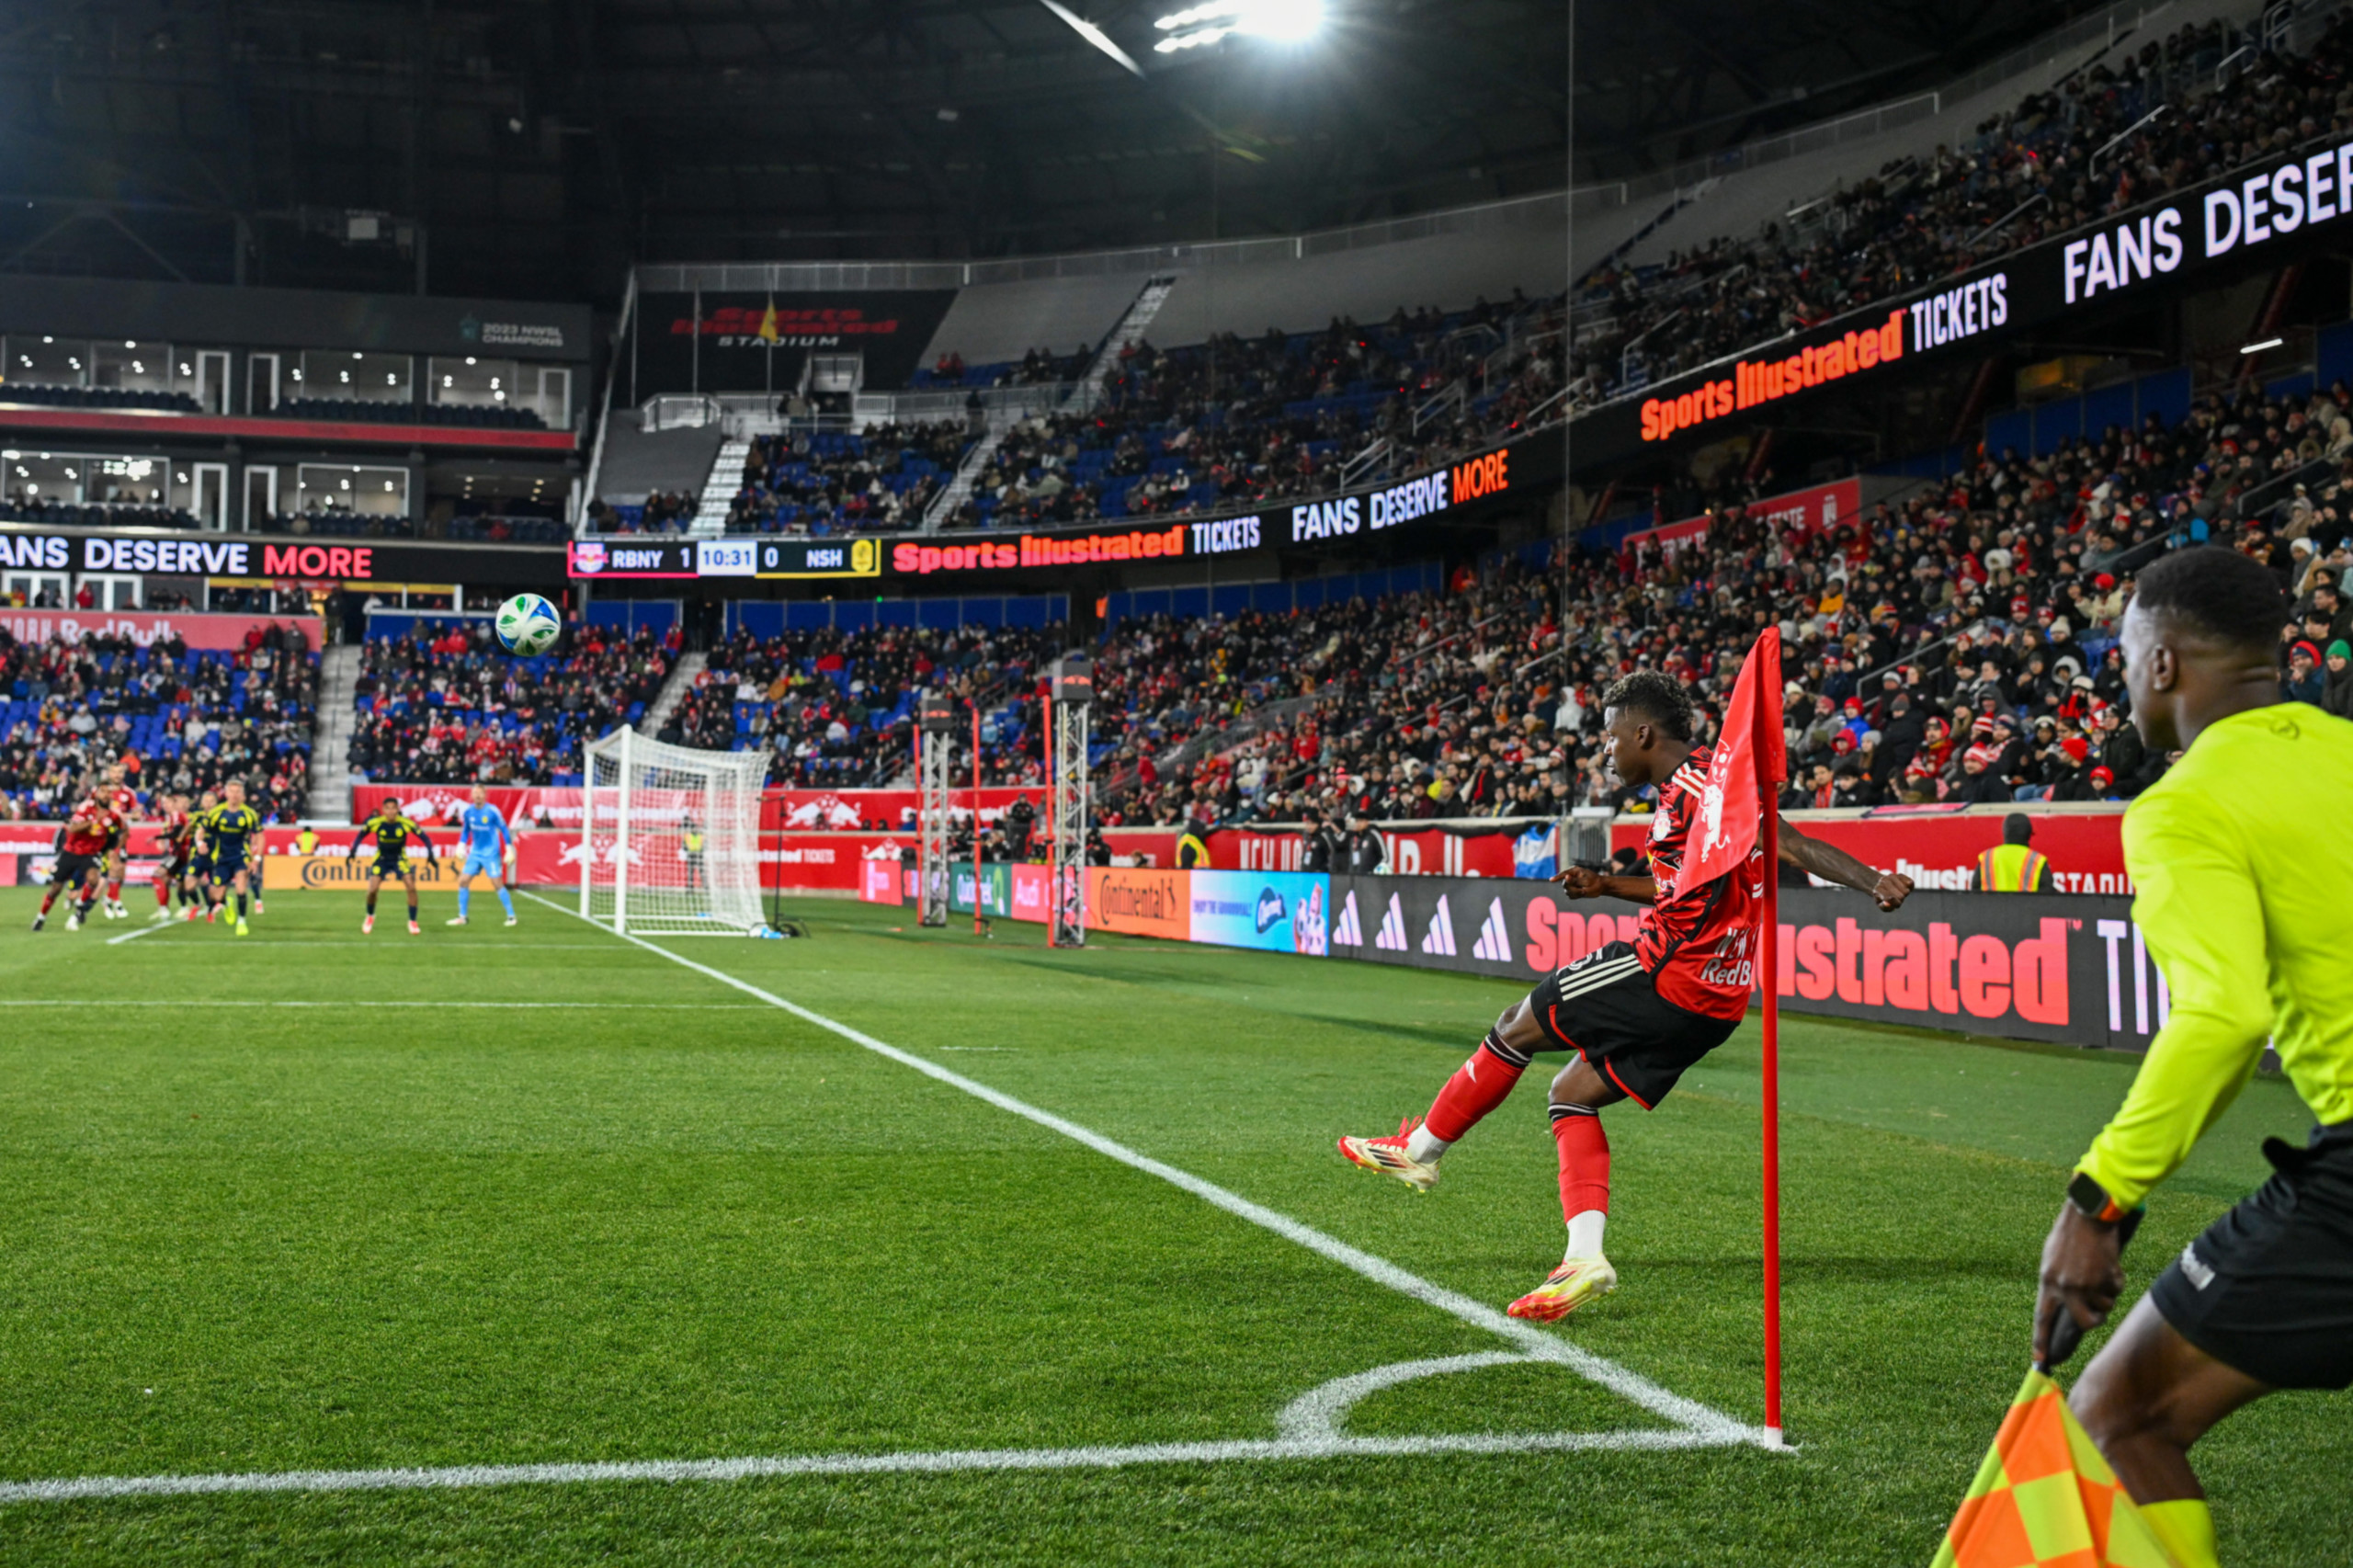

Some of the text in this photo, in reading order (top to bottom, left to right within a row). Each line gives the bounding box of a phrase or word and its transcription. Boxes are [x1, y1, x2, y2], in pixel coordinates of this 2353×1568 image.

[2064, 208, 2183, 304] FANS
[1641, 273, 2007, 441] Sports Illustrated TICKETS
[1292, 449, 1509, 542] FANS DESERVE MORE
[85, 538, 249, 574] DESERVE
[264, 544, 373, 578] MORE
[612, 547, 664, 568] RBNY
[680, 547, 690, 568] 1
[703, 549, 752, 566] 10:31
[765, 547, 779, 568] 0
[806, 549, 843, 567] NSH
[893, 516, 1261, 574] Sports Illustrated TICKETS
[1099, 875, 1165, 926] Continental
[1526, 896, 1655, 972] Spor
[1750, 917, 2069, 1026] ustrated
